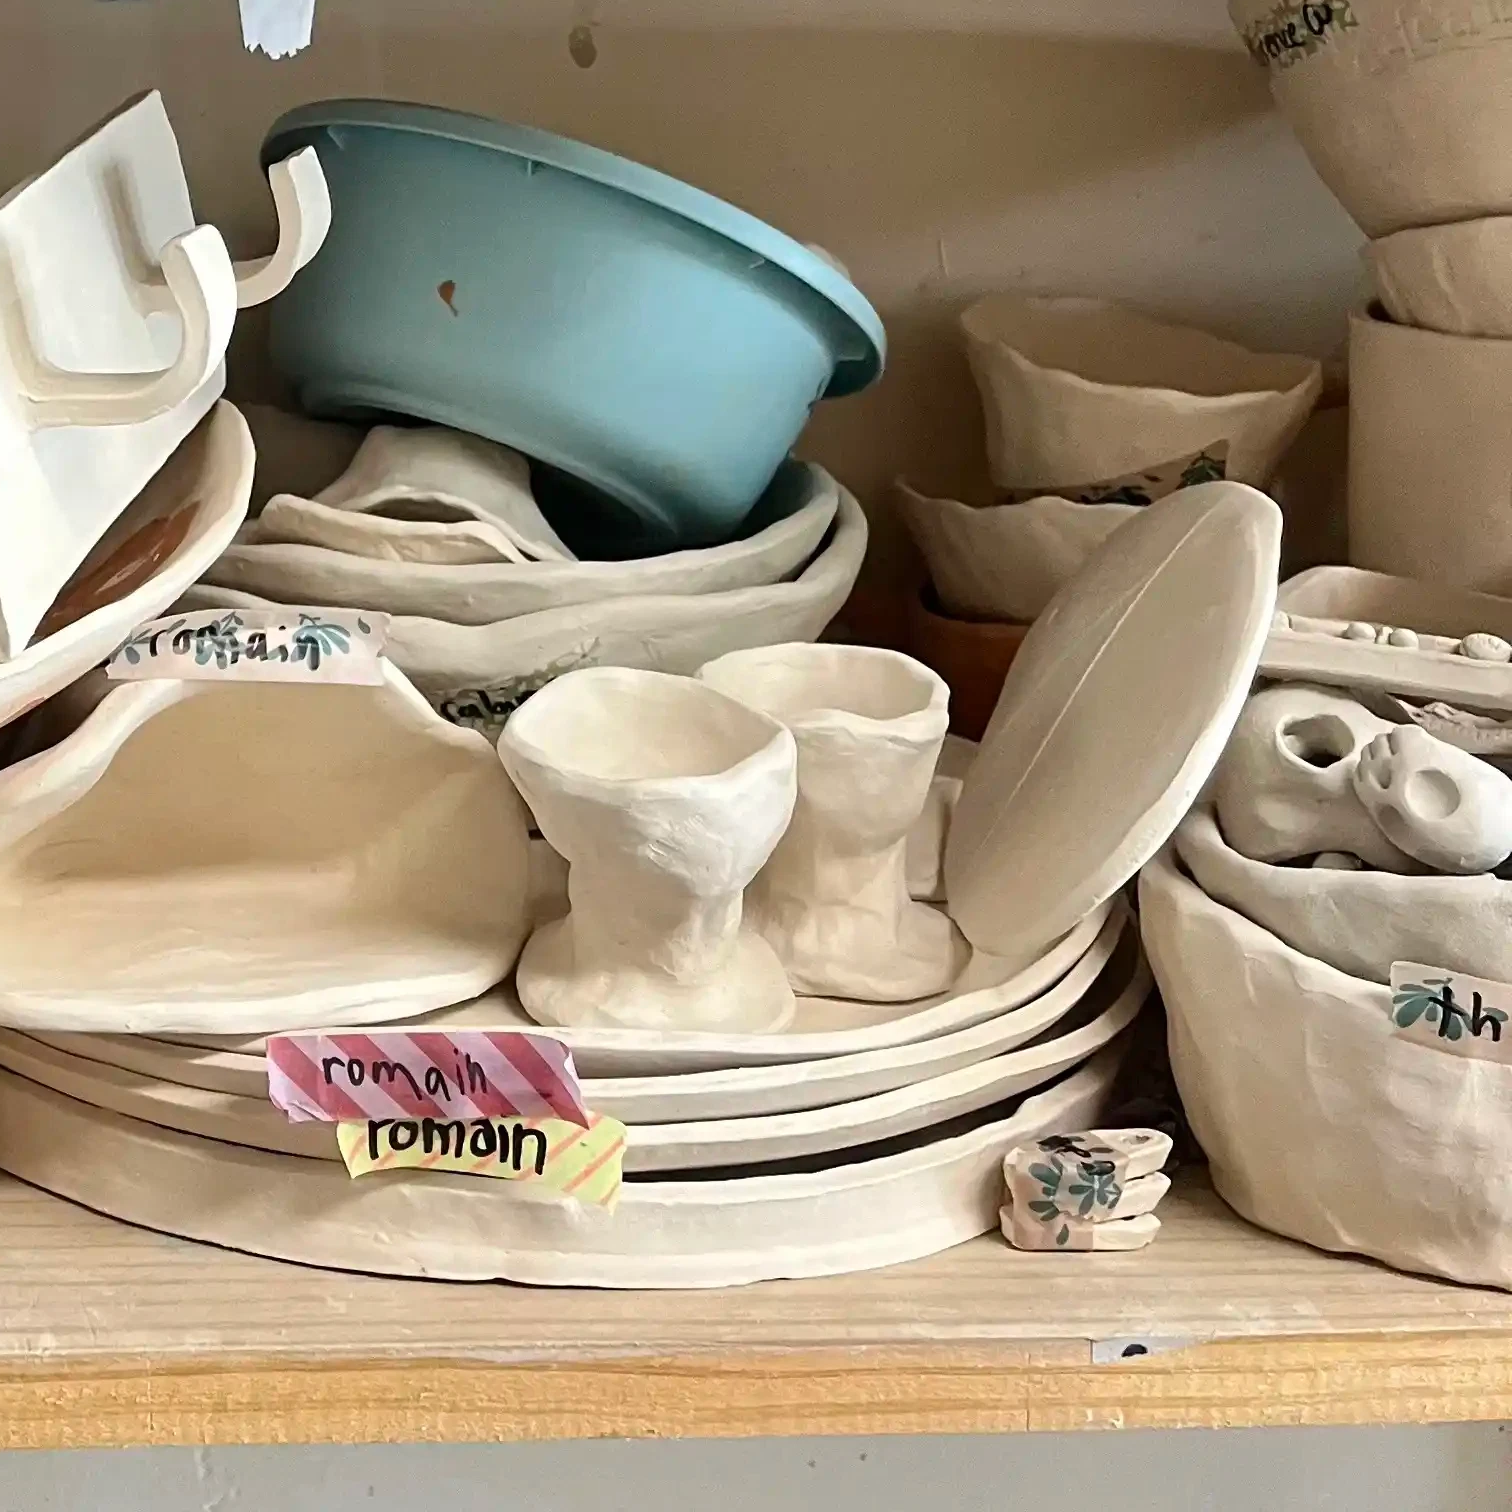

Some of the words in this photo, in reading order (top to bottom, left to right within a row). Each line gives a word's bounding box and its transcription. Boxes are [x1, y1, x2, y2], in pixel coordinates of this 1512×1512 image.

[148, 625, 320, 672] romain
[322, 1047, 490, 1102] romain
[366, 1113, 548, 1176] romain
